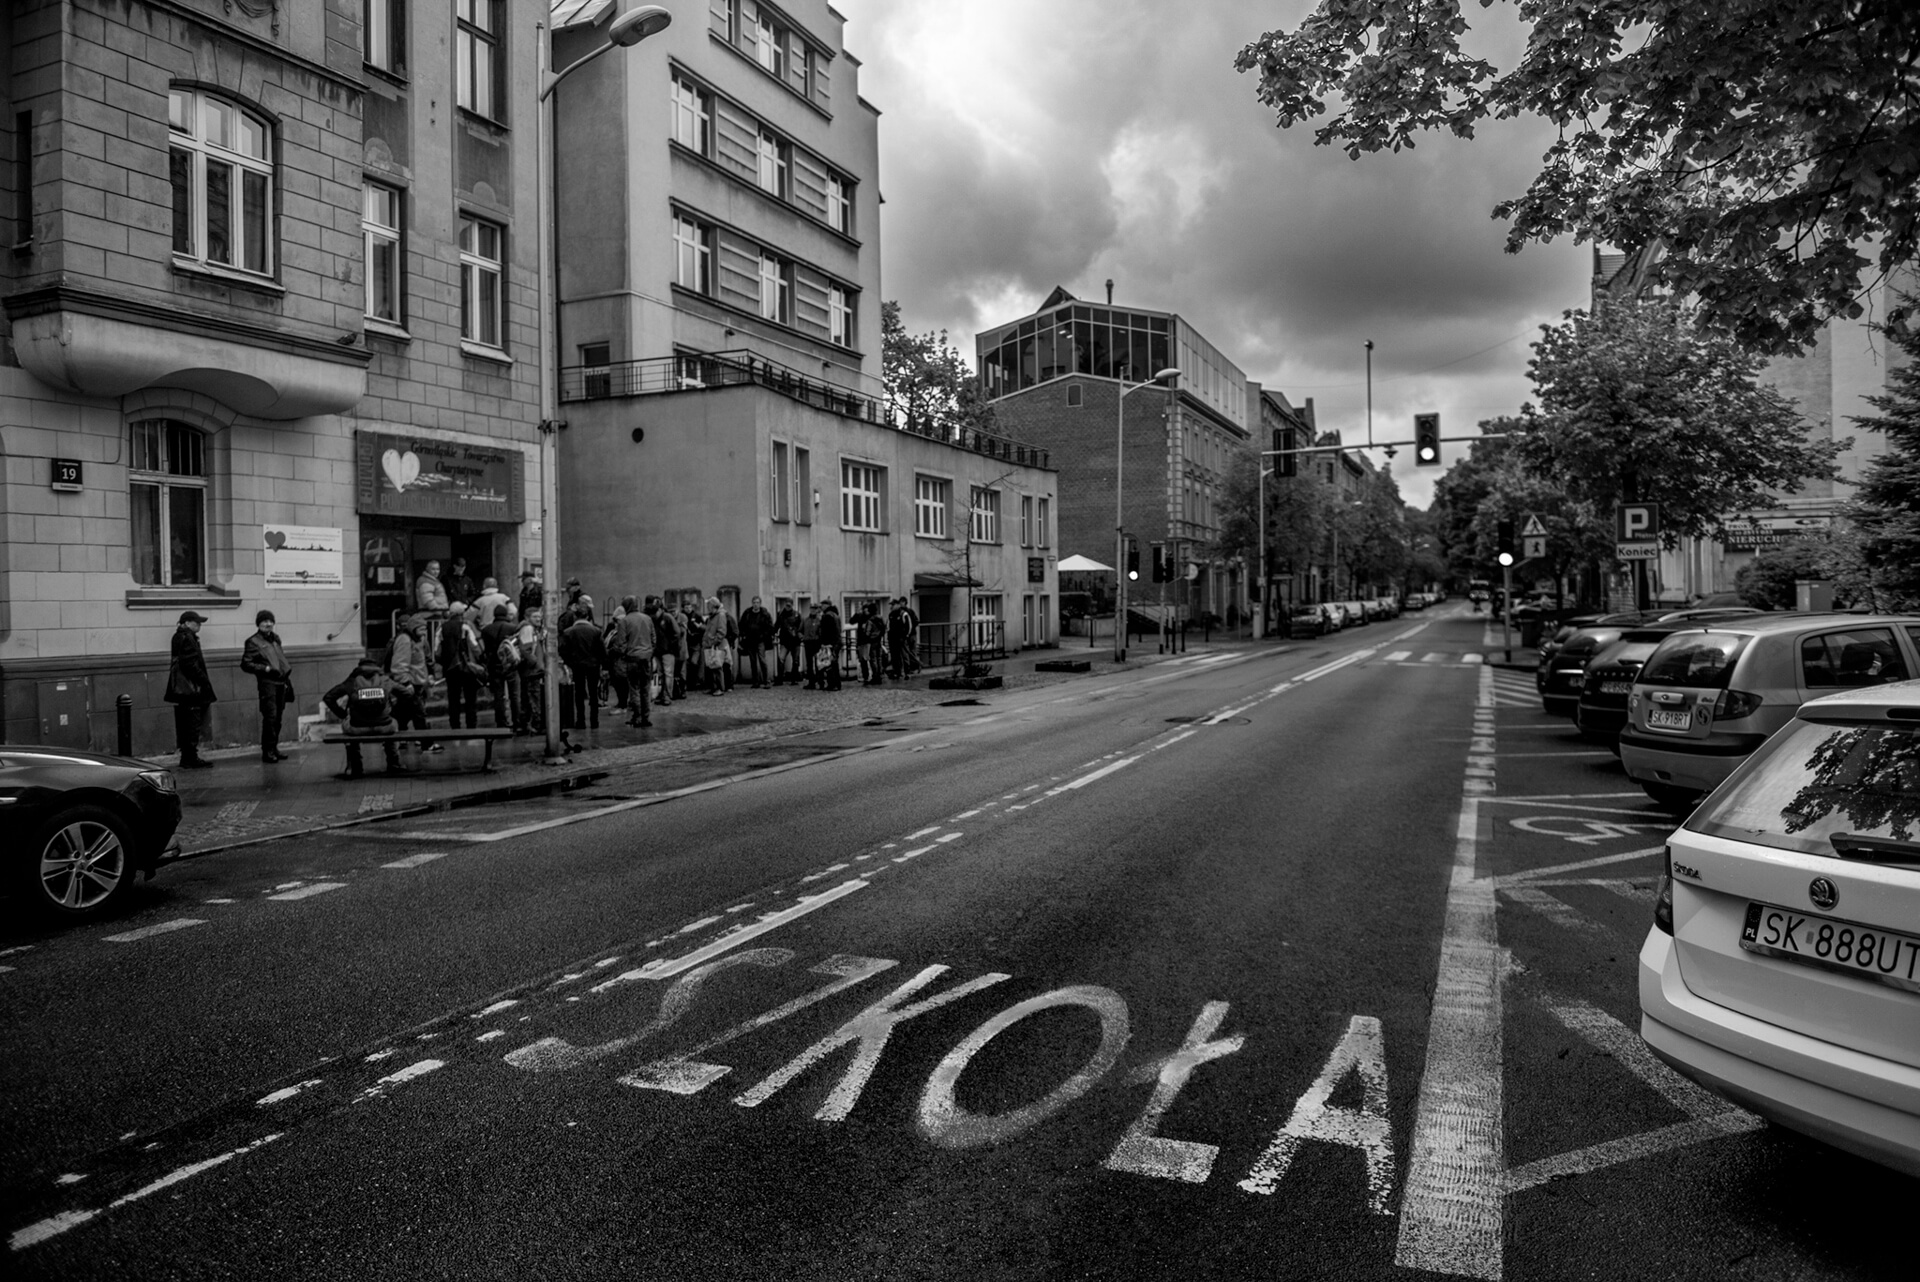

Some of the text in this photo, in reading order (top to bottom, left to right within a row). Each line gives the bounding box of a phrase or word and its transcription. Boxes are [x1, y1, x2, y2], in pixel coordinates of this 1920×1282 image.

[62, 468, 77, 480] 19
[1625, 508, 1649, 538] P
[1618, 546, 1656, 557] Koniec
[1745, 927, 1756, 939] PL
[1763, 912, 1920, 980] SK 888UT
[502, 946, 1396, 1217] SZKOŁA
